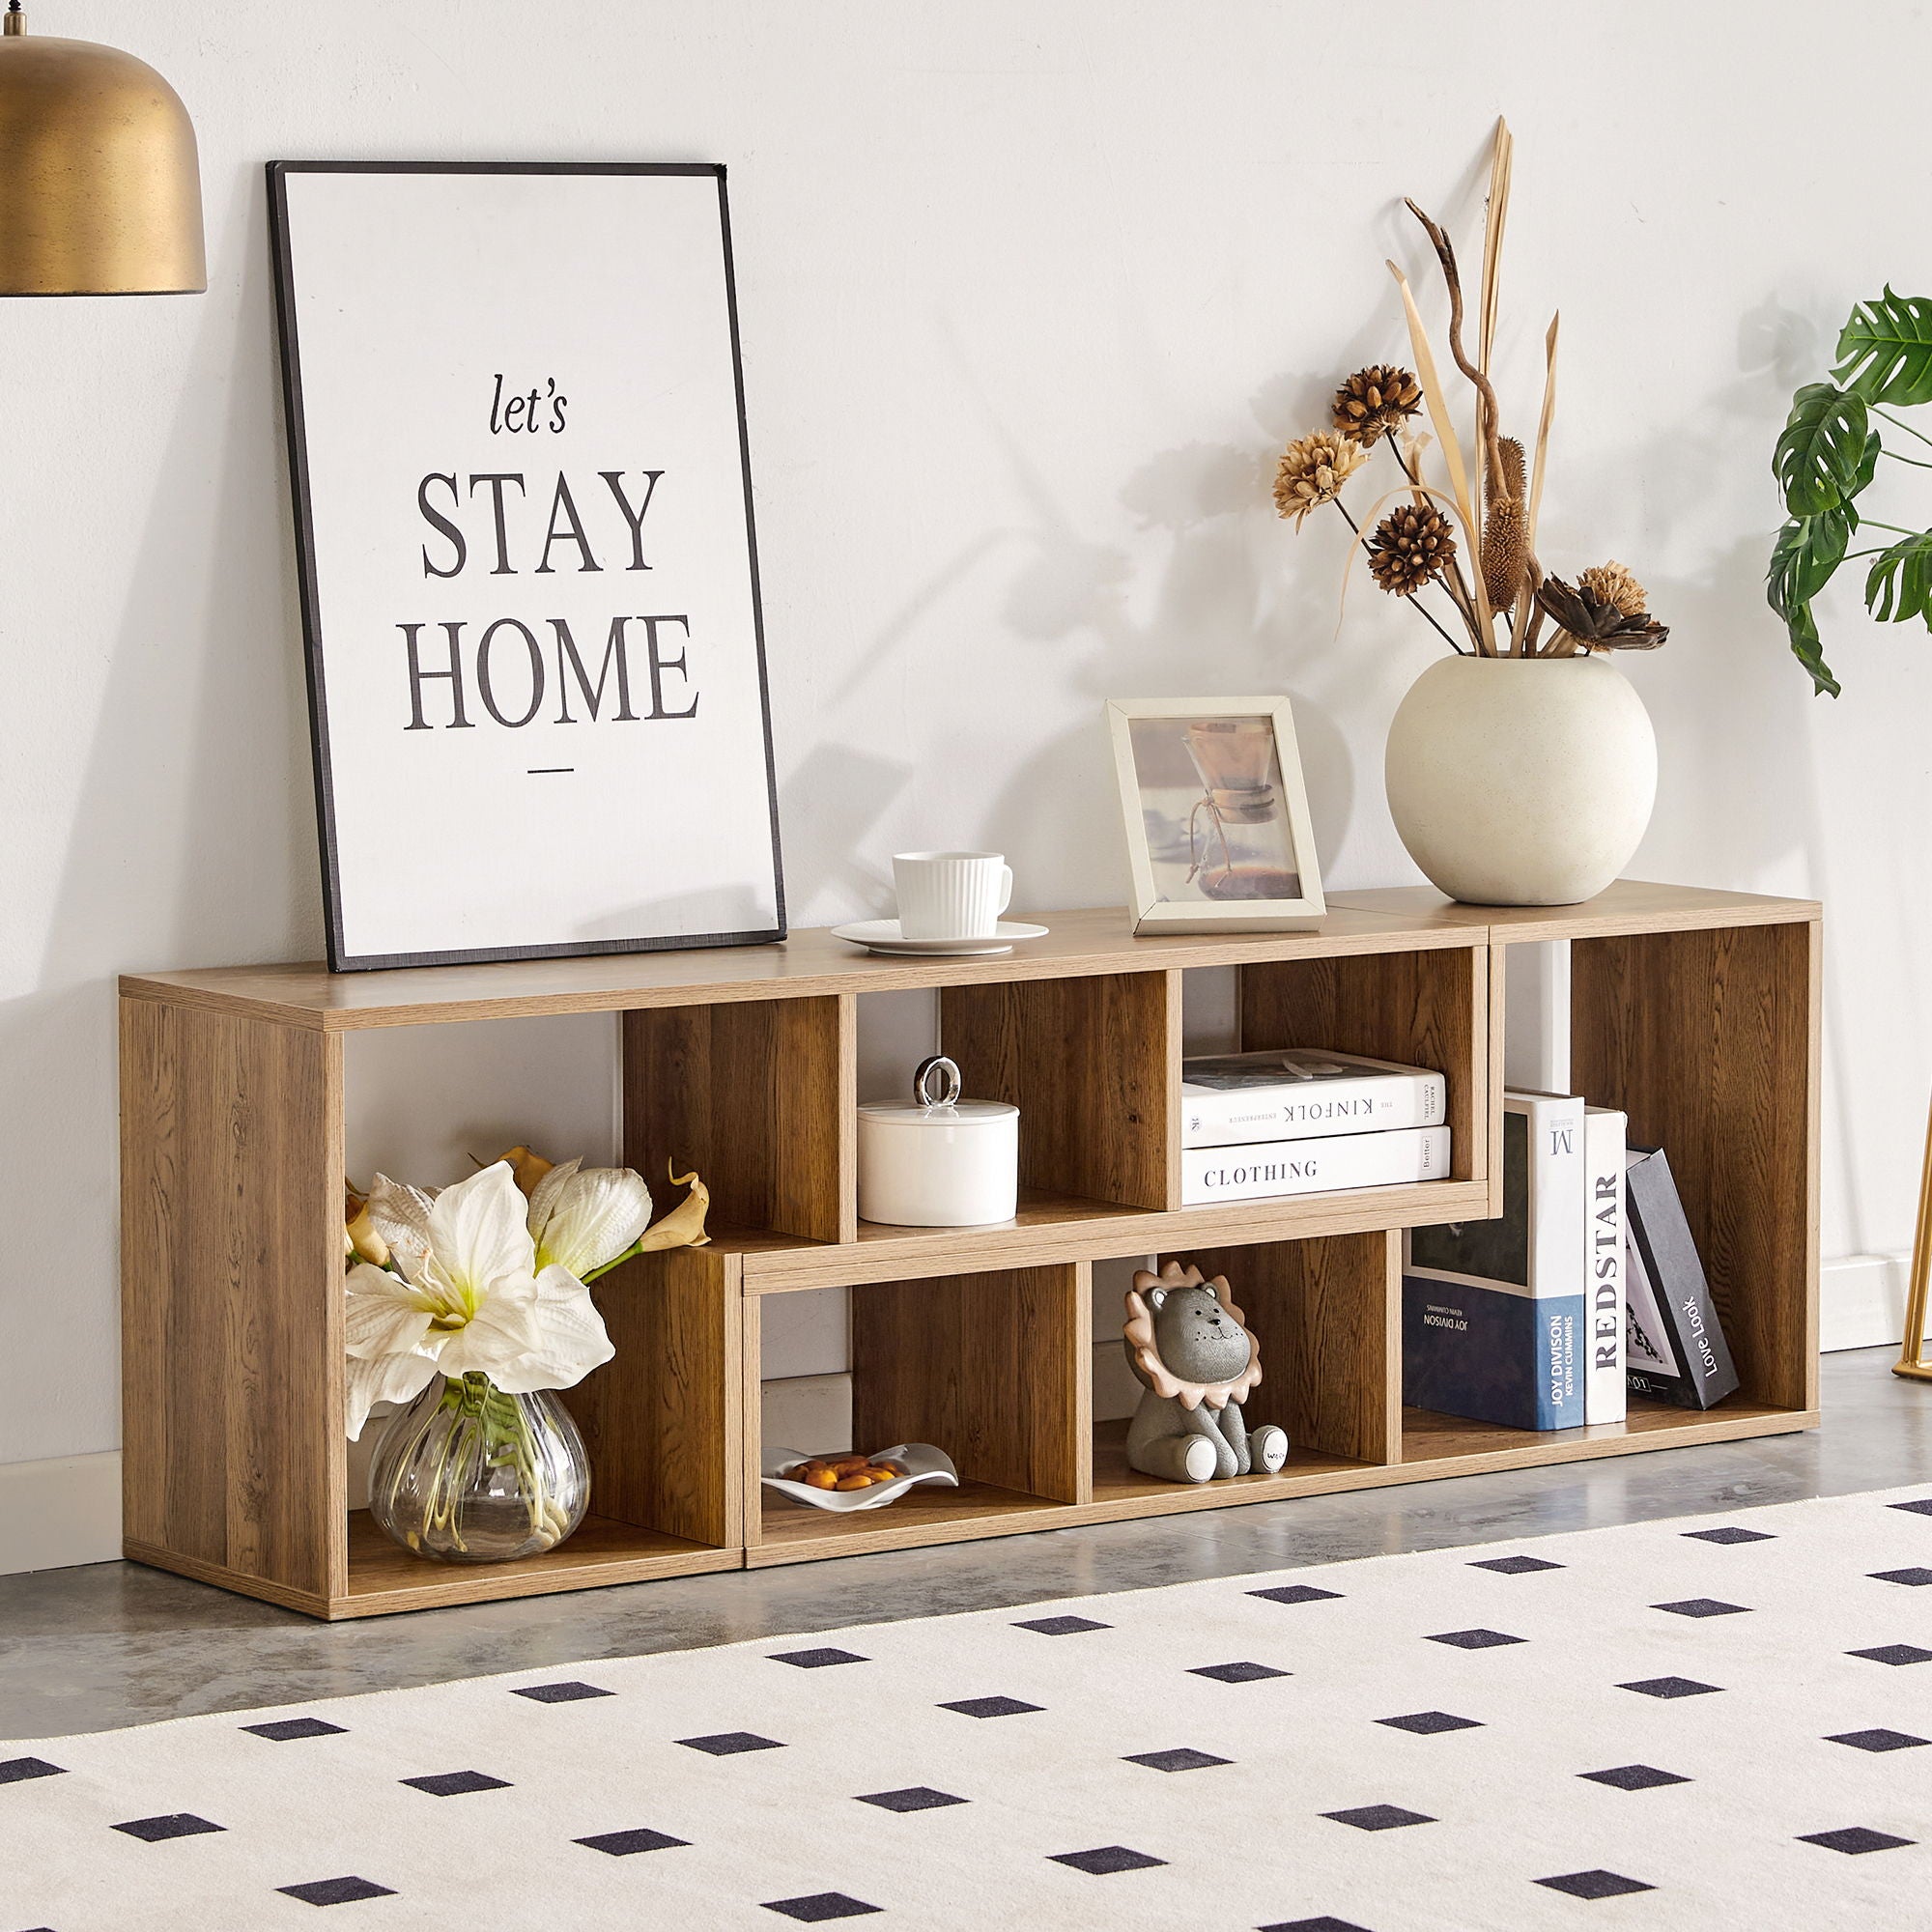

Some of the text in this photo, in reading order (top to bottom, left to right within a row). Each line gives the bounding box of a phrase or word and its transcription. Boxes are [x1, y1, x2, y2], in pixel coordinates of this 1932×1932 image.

[489, 373, 568, 436] let's
[417, 469, 666, 580] STAY
[395, 613, 700, 731] HOME
[1283, 1098, 1373, 1122] KINFOLK
[1550, 1129, 1574, 1156] M
[1204, 1160, 1319, 1187] CLOTHING
[1595, 1172, 1618, 1372] REDSTAR
[1423, 1314, 1468, 1331] JOY DIVISON
[1550, 1315, 1563, 1406] JOY DIVISON
[1565, 1316, 1574, 1396] KEVIN CUMMINS
[1682, 1295, 1719, 1378] Love Look
